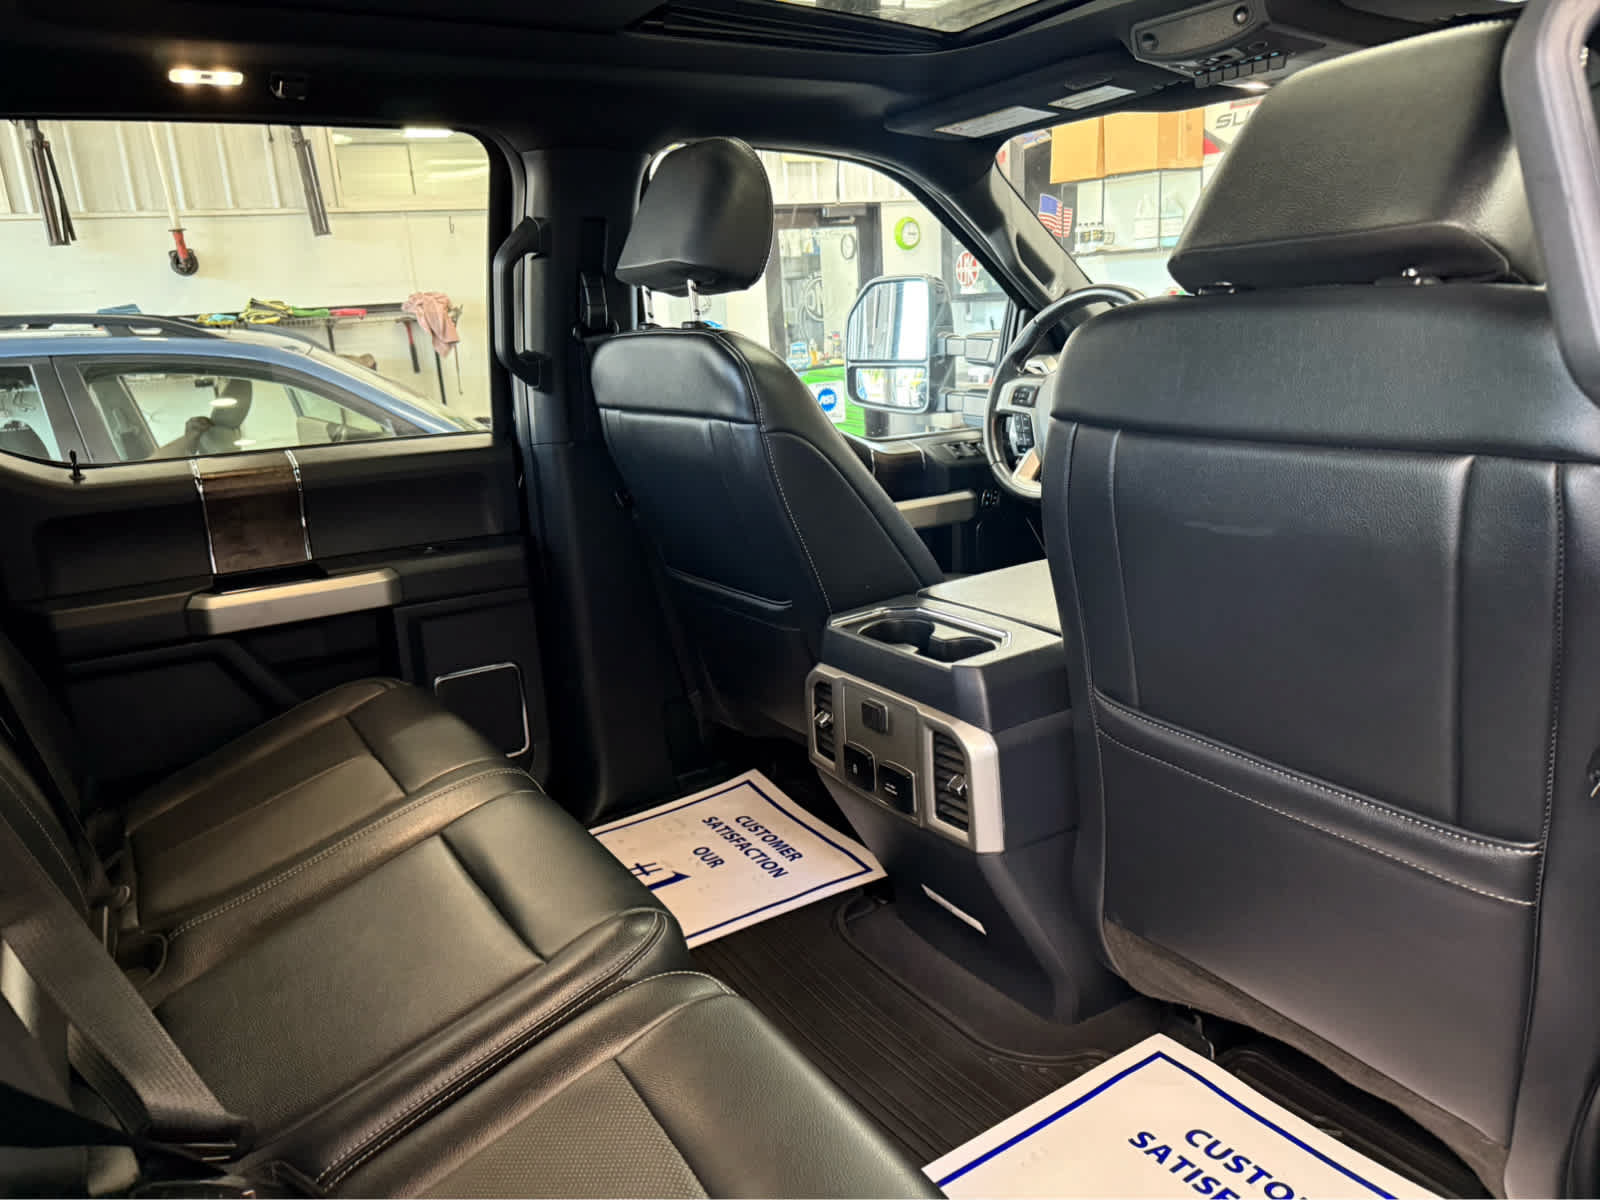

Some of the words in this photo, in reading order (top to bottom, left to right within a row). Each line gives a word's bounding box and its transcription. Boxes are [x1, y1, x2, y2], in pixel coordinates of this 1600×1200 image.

[692, 846, 725, 869] OUR
[702, 816, 789, 878] SATISFACTION
[735, 815, 803, 862] CUSTOMER
[1185, 1129, 1308, 1200] CUSTO
